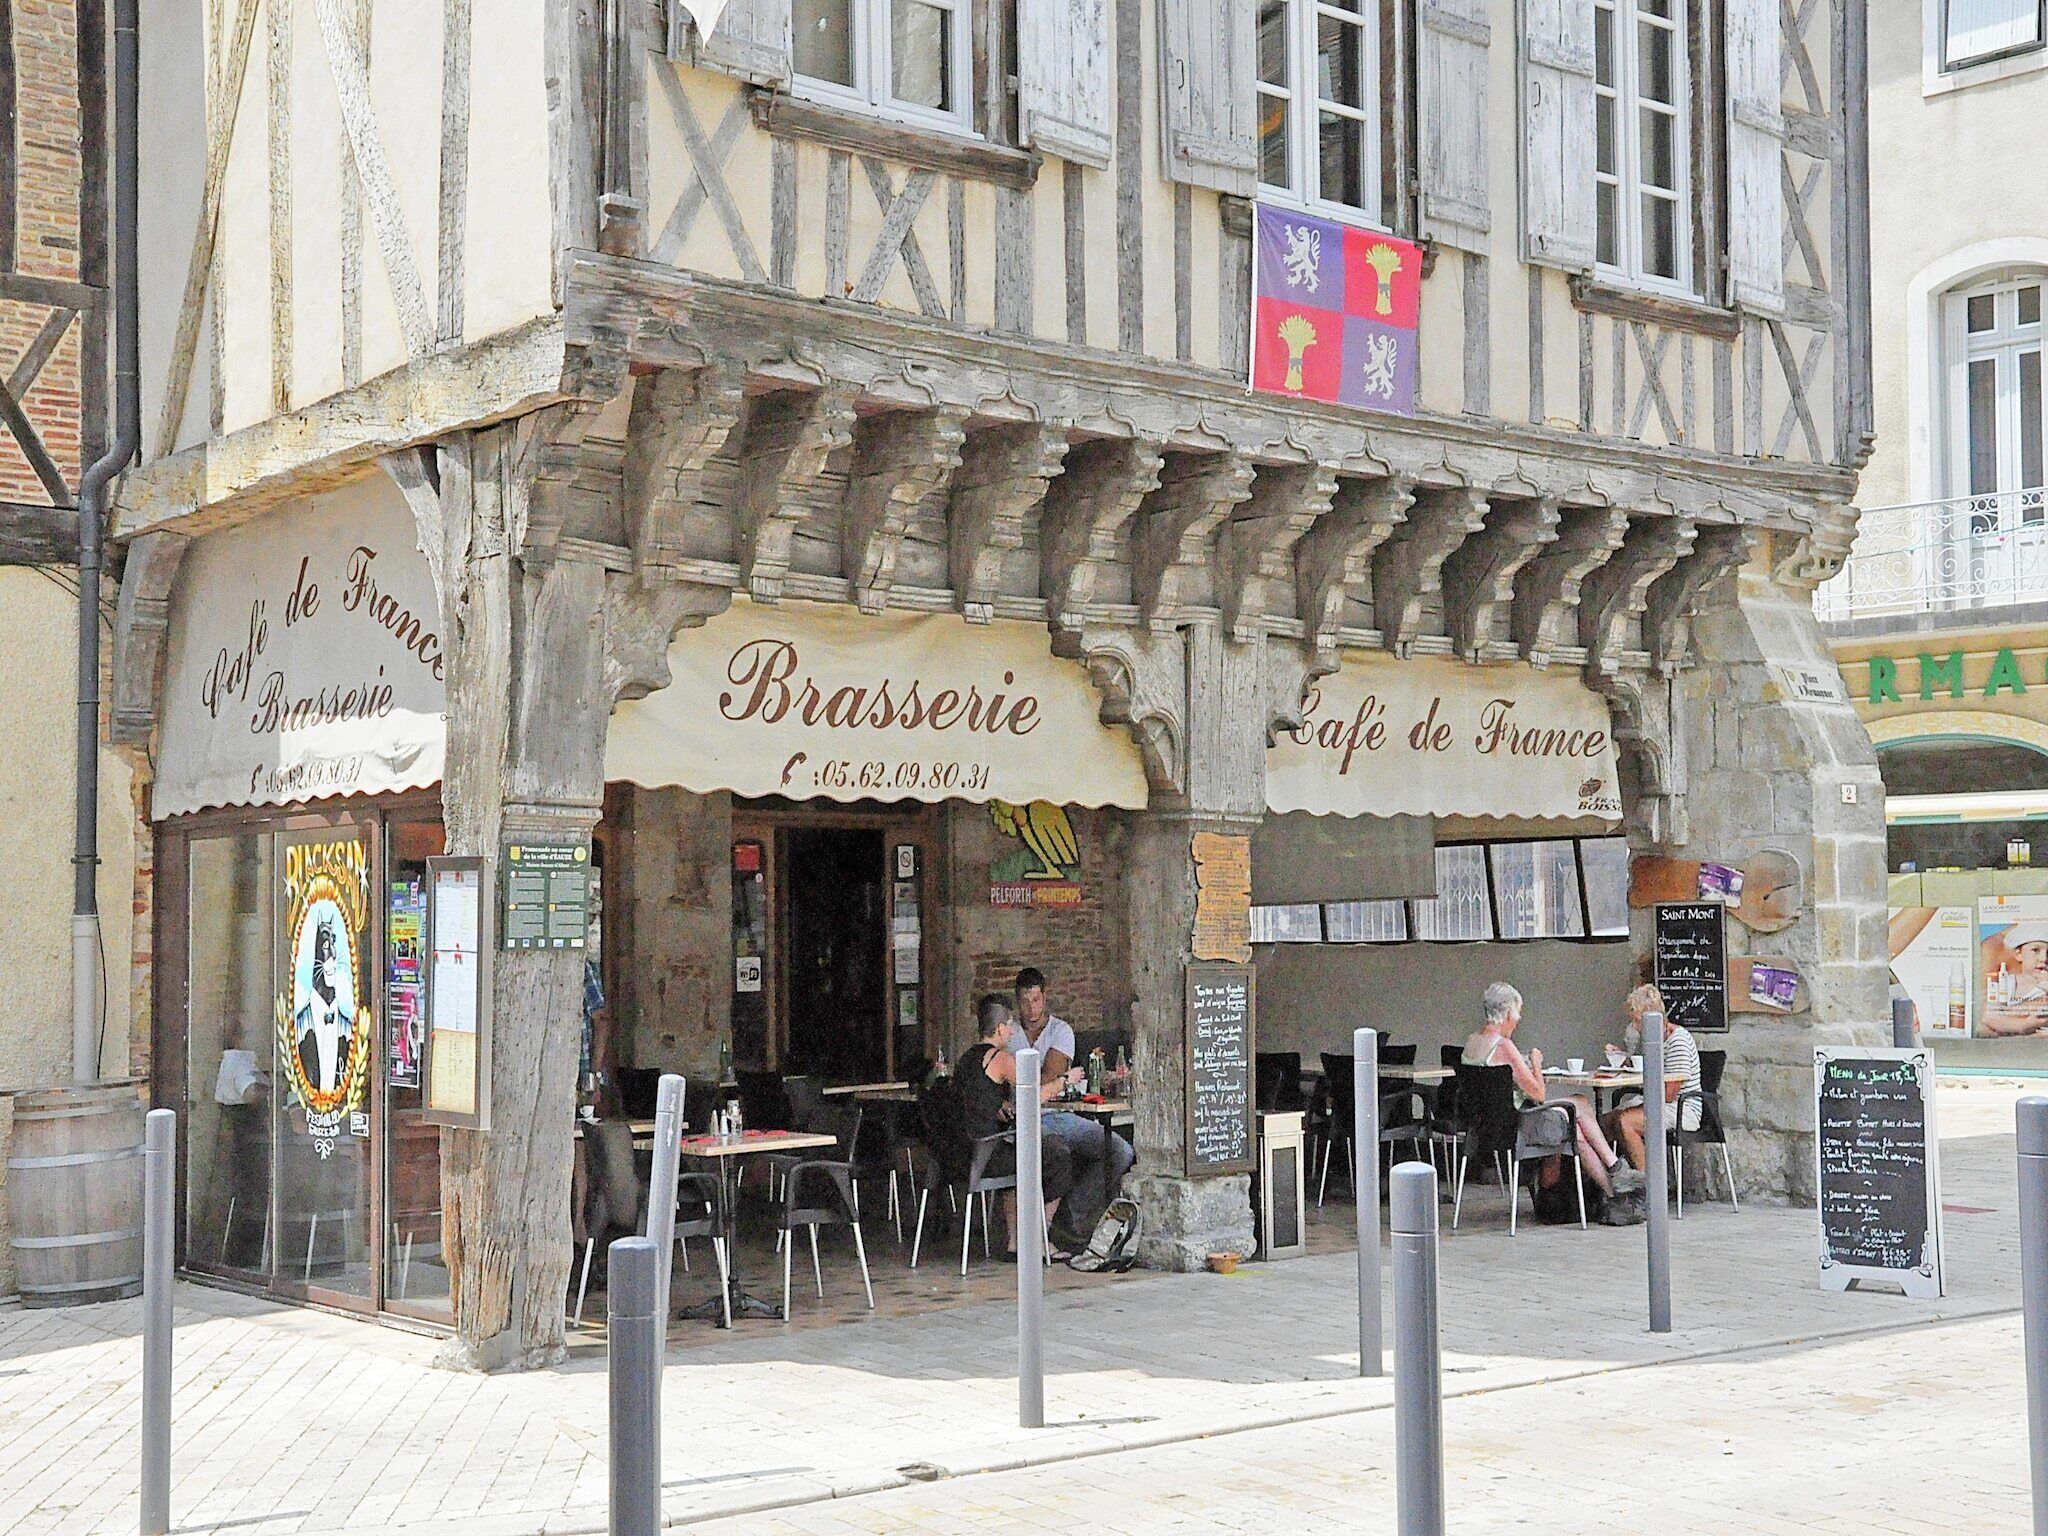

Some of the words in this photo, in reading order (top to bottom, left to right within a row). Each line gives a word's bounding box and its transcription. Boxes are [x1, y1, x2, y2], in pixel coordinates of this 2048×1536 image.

[202, 599, 269, 719] Café
[286, 556, 321, 628] de
[251, 664, 394, 734] Brasserie
[719, 639, 1041, 735] Brasserie
[1290, 688, 1387, 775] Café
[1408, 697, 1453, 751] de
[1475, 699, 1607, 757] France
[1846, 787, 1853, 800] 2
[990, 887, 1032, 904] PELFORTH
[1661, 909, 1687, 921] SAINT
[1687, 908, 1716, 920] MONT
[1829, 1066, 1853, 1079] MENU
